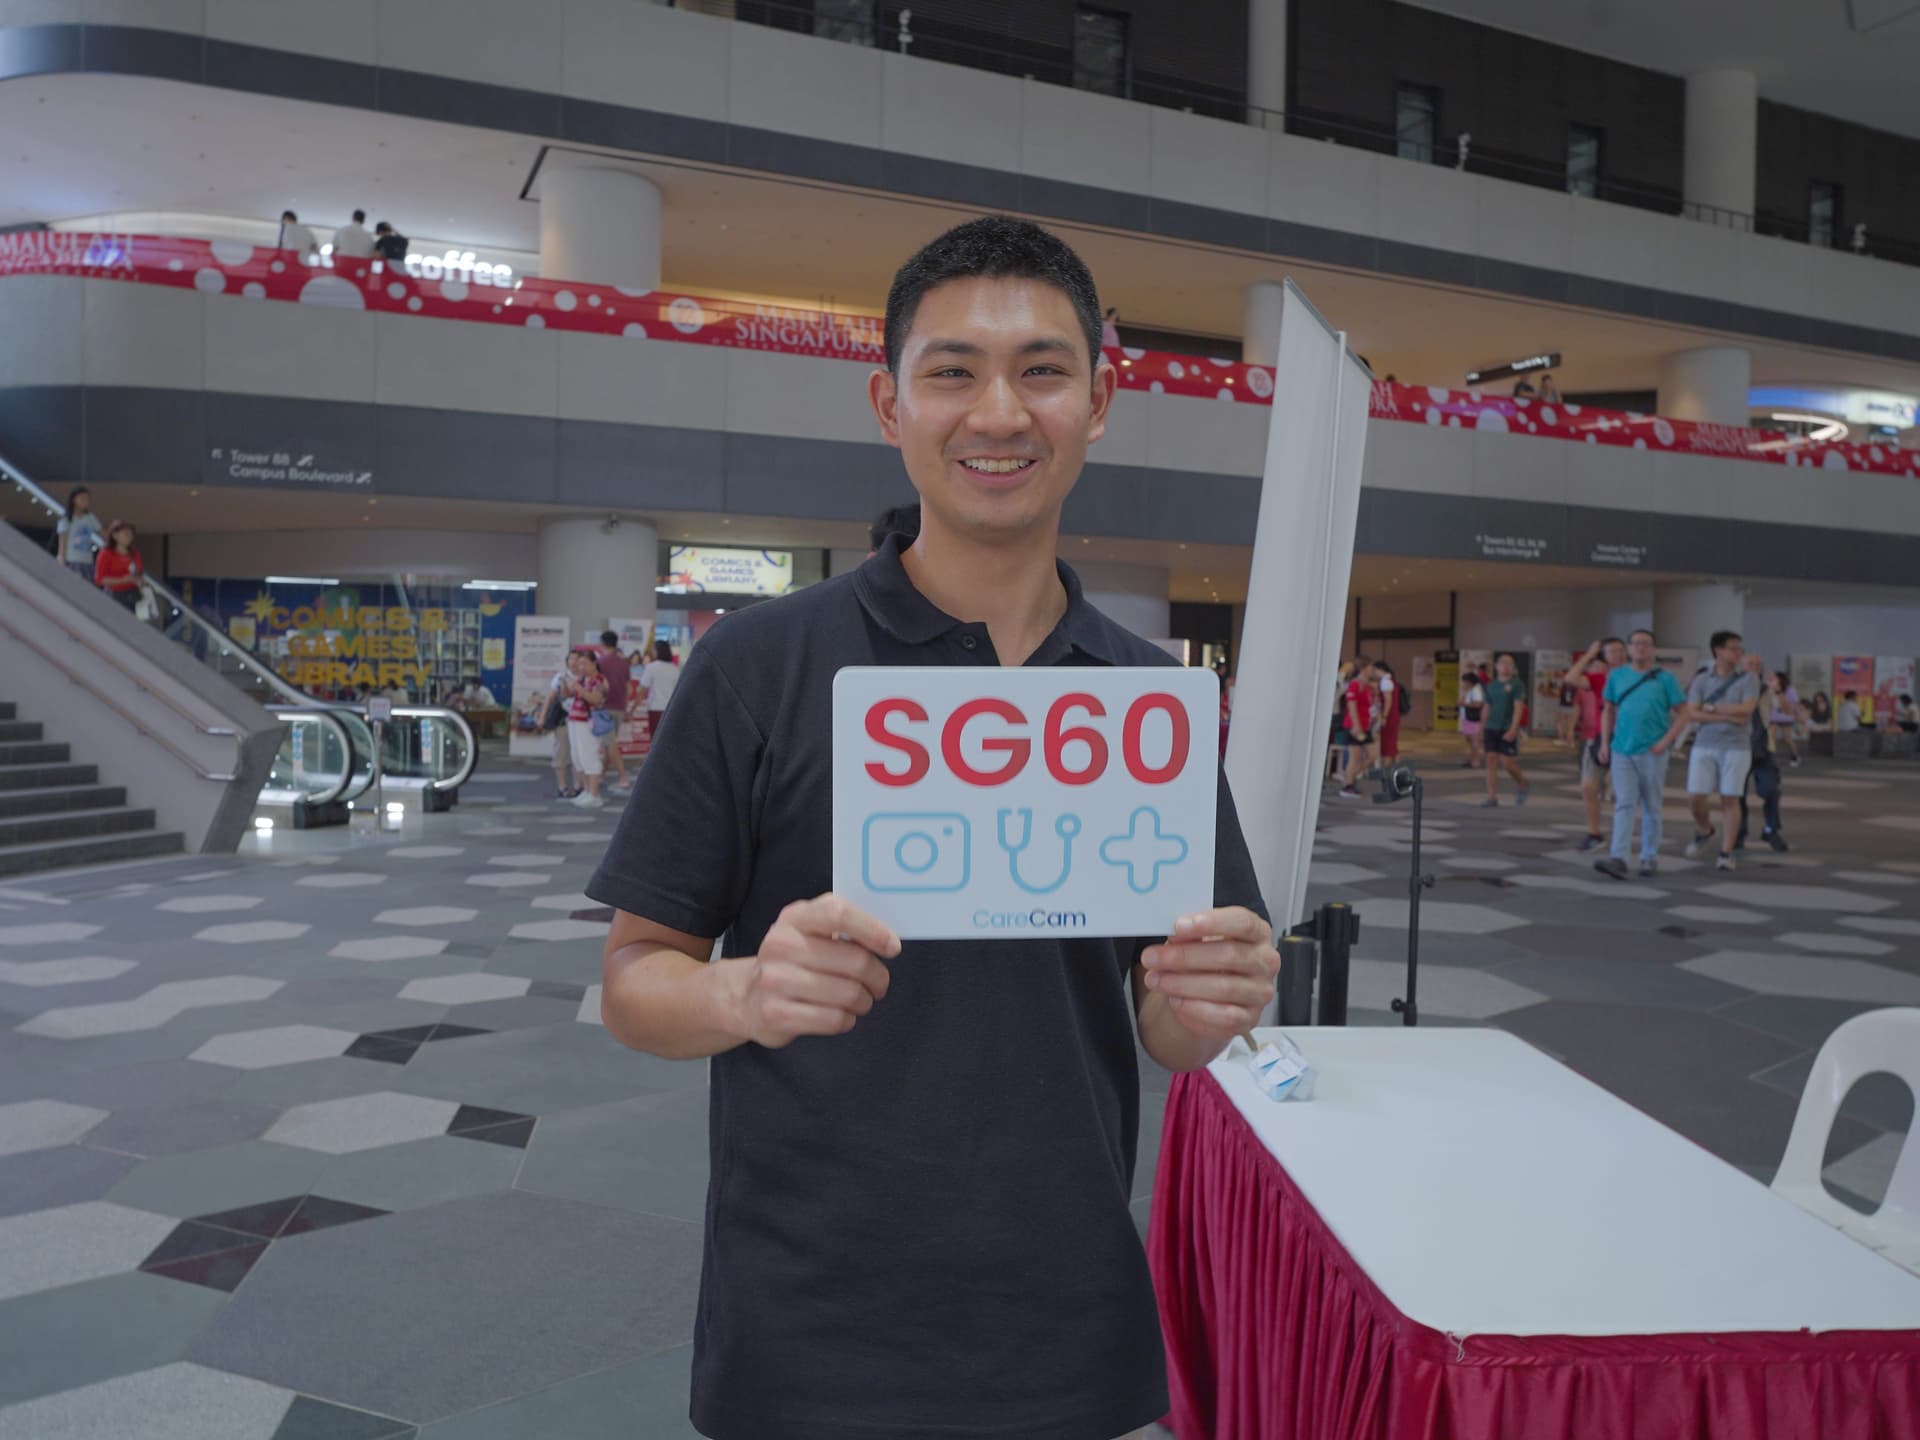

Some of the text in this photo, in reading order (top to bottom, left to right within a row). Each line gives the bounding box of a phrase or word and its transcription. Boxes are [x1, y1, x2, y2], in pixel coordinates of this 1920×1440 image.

[404, 250, 513, 288] coffee
[753, 304, 877, 332] MAJULAH
[735, 318, 883, 354] SINGAPURA
[230, 449, 270, 465] Tower
[229, 464, 354, 484] Campus Boulevard
[270, 605, 413, 631] COMICS
[287, 635, 417, 658] GAMES
[278, 661, 433, 687] LIBRARY
[864, 692, 1191, 787] SG60
[972, 908, 1087, 929] CareCam
